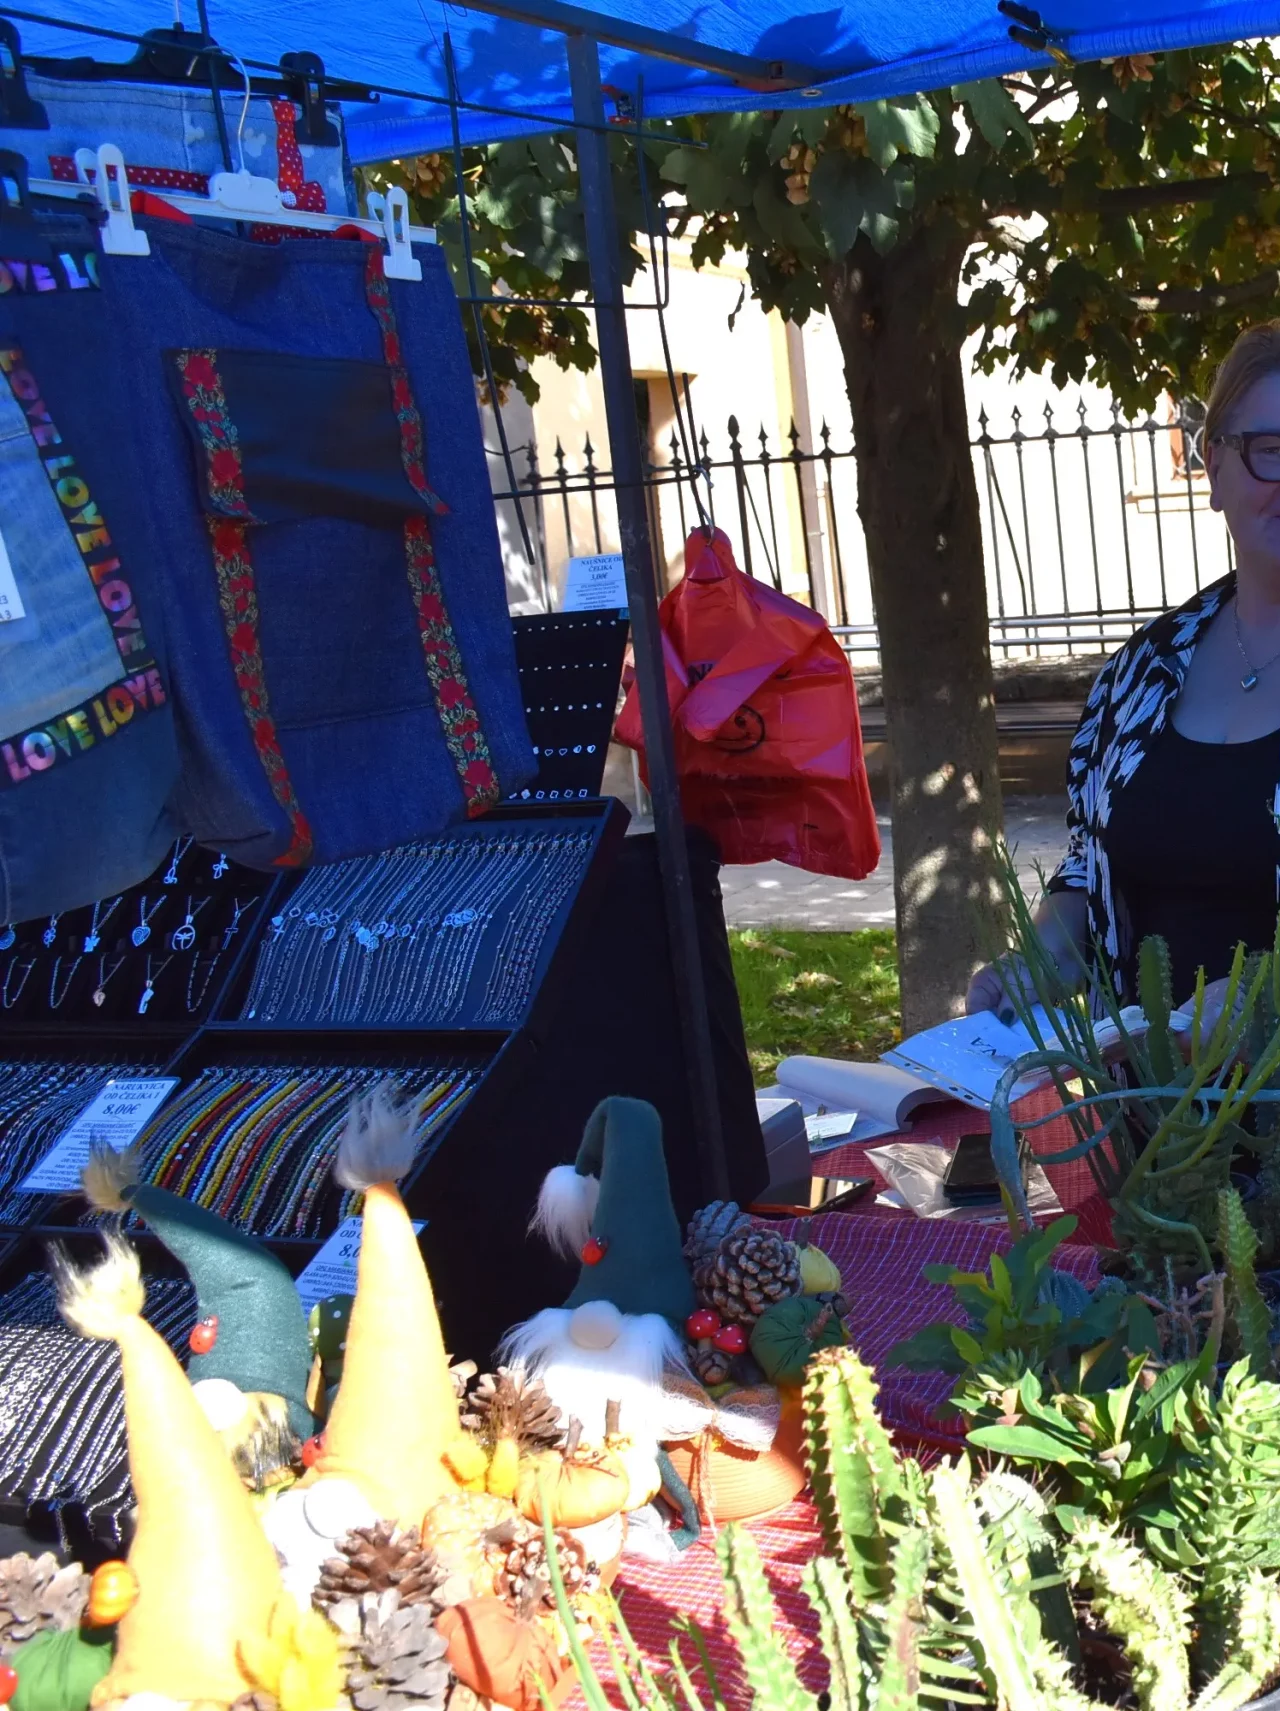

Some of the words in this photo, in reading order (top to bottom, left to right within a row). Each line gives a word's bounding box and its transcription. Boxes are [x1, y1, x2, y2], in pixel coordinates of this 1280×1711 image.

[0, 261, 57, 293] OVE
[45, 455, 112, 554] LOVE
[90, 557, 147, 657] LOVE
[2, 710, 95, 784] LOVE
[93, 668, 167, 738] LOVE
[103, 1092, 119, 1100] OD
[119, 1091, 153, 1100] ČELIKA
[114, 1082, 166, 1091] NARUKVICA
[340, 1229, 356, 1239] OD
